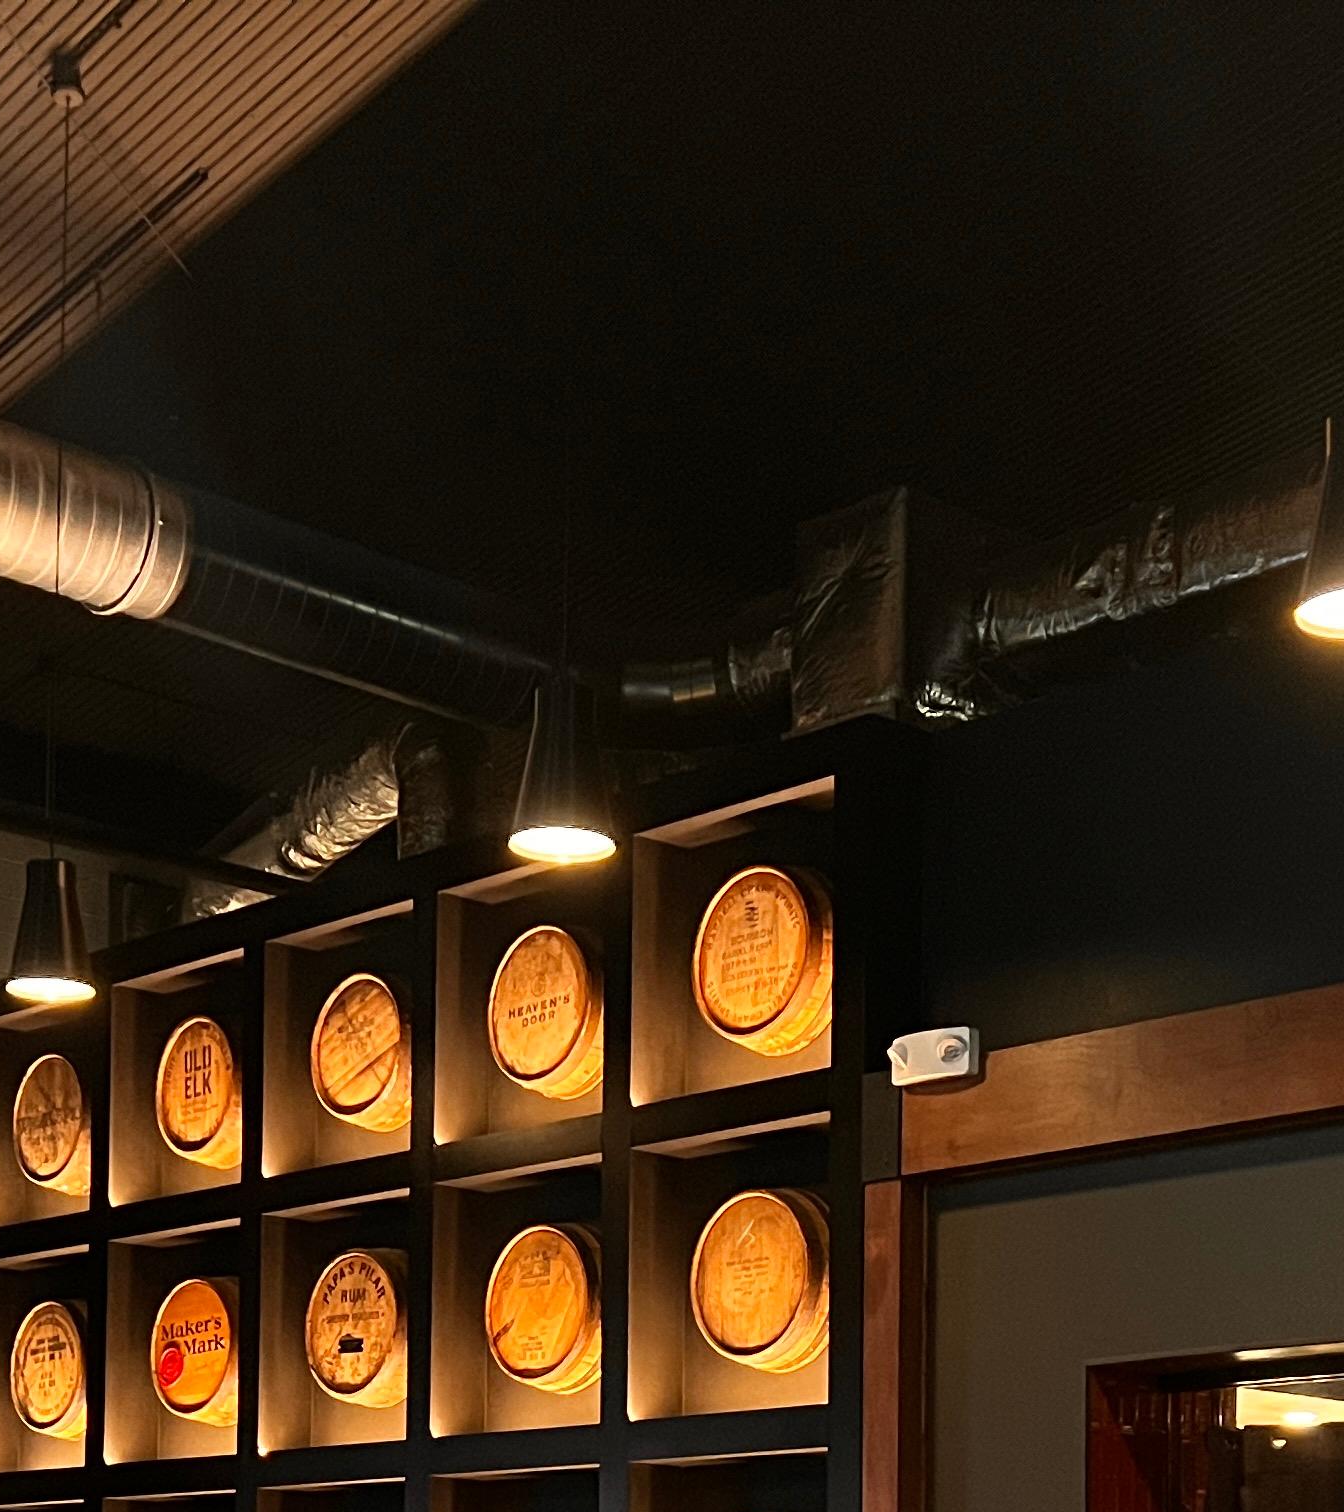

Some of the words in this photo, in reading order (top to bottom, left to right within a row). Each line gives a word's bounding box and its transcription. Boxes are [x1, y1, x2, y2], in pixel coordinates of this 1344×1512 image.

[508, 994, 571, 1020] HEAVEN'S
[521, 1010, 556, 1028] DOOR
[184, 1045, 212, 1075] OLD
[184, 1072, 212, 1099] ELK
[358, 1261, 386, 1300] PILAR
[340, 1287, 367, 1304] RUM
[160, 1315, 223, 1341] Maker's
[184, 1334, 226, 1357] Mark
